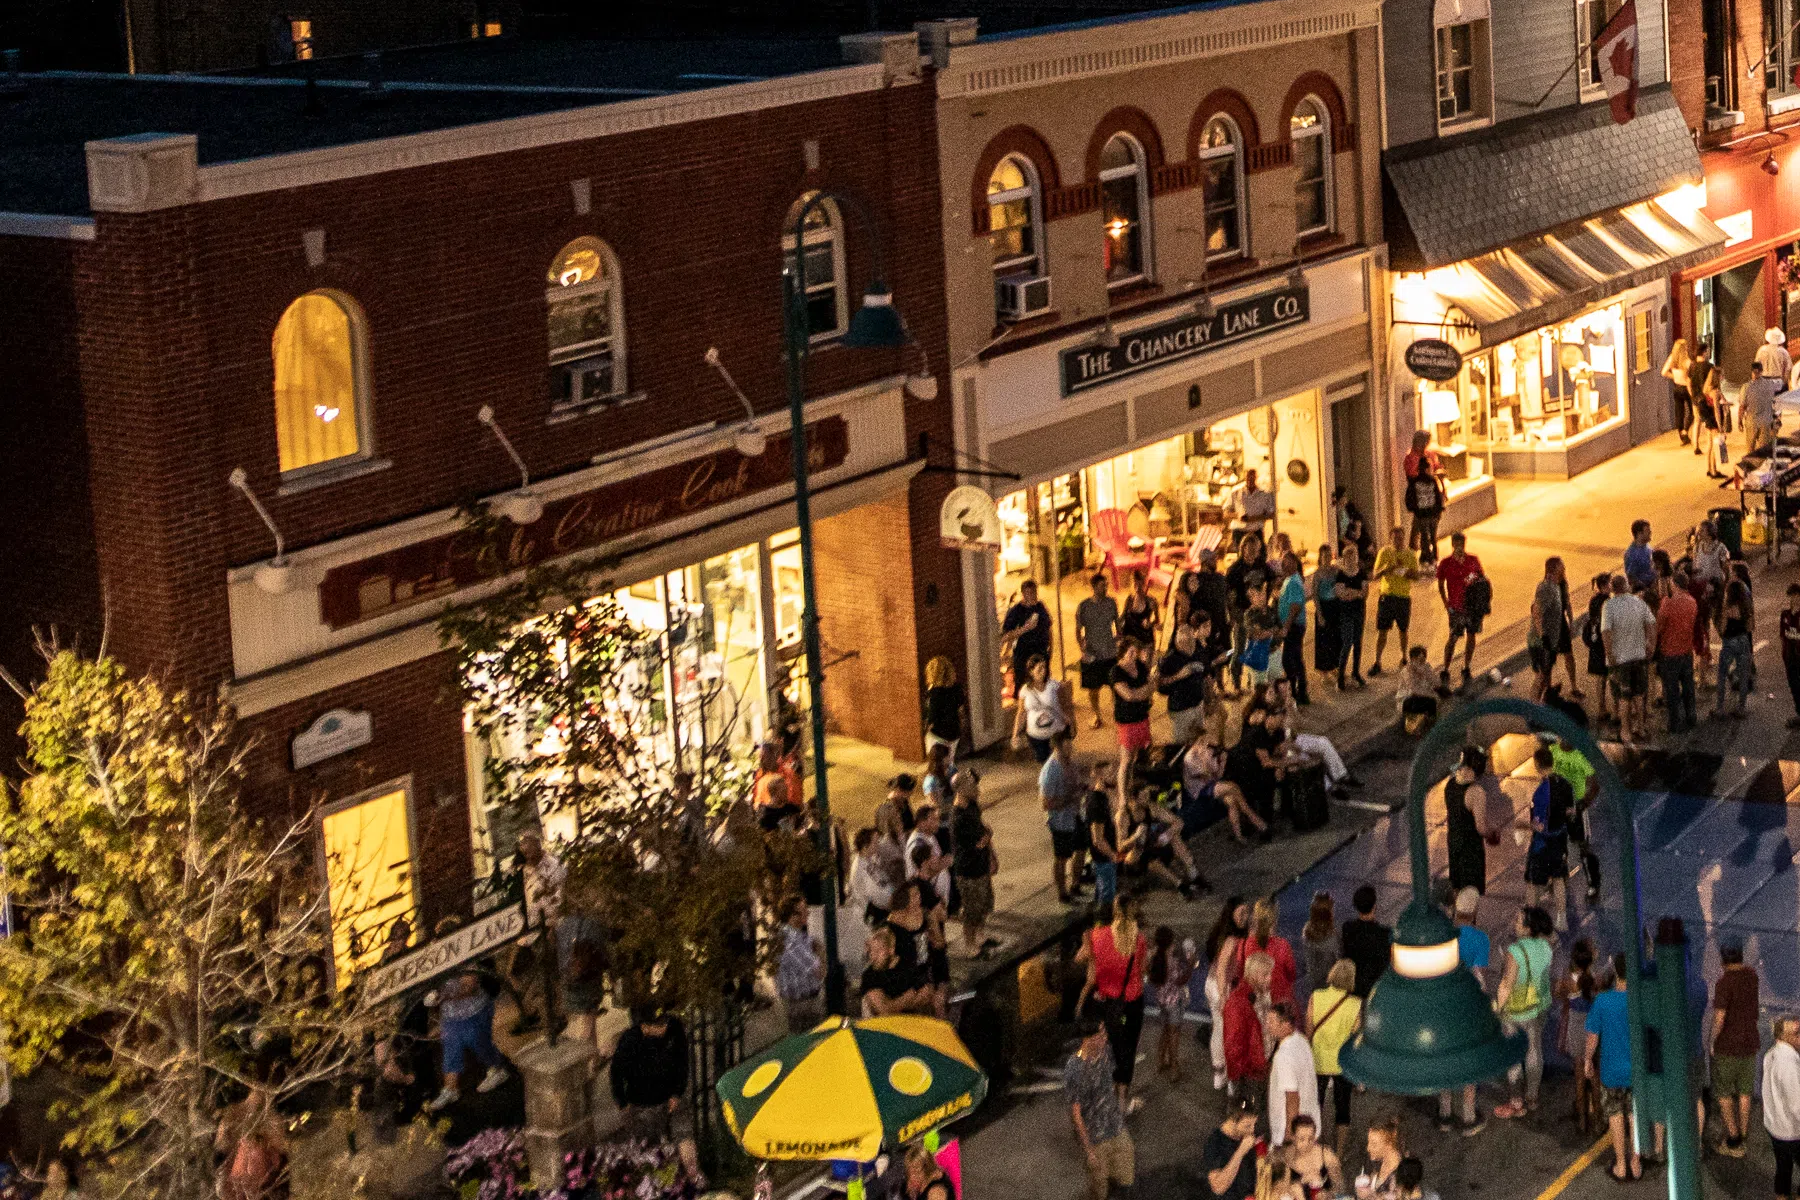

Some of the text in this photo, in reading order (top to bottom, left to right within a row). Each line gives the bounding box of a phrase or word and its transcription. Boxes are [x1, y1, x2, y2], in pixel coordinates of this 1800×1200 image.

[1078, 351, 1112, 379] THE
[1126, 322, 1213, 365] CHANCERY
[1223, 308, 1260, 336] LANE
[469, 912, 520, 951] LANE
[763, 1135, 863, 1156] LEMONADE
